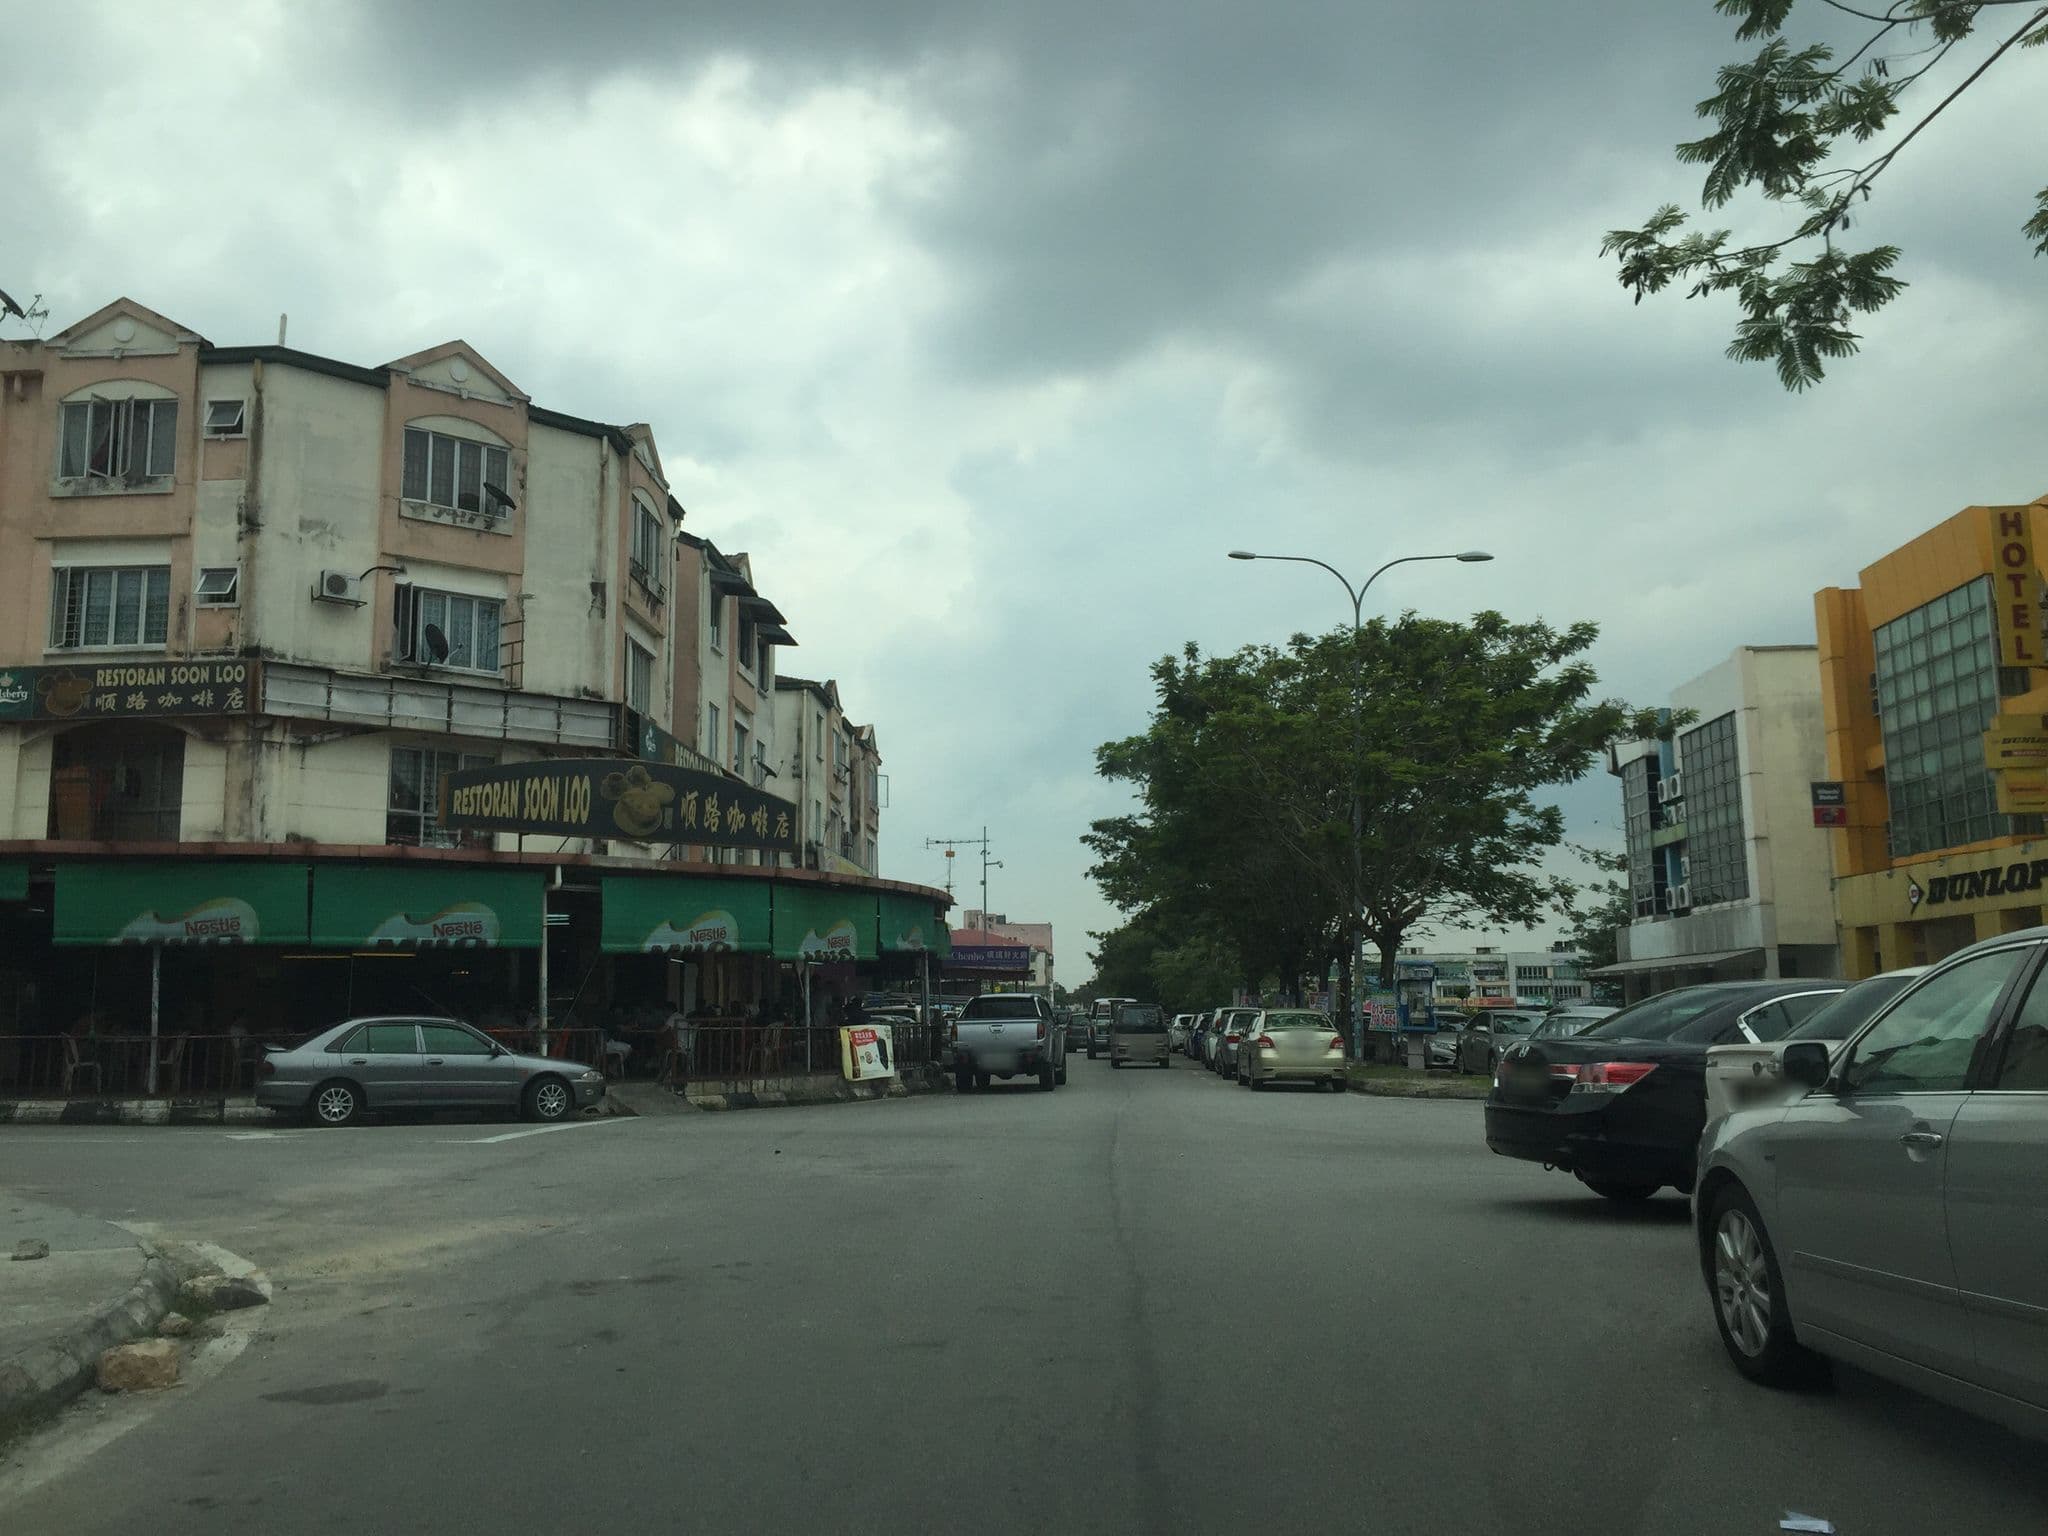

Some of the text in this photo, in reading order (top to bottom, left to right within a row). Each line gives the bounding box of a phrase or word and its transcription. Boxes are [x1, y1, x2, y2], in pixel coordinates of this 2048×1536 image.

[1999, 512, 2033, 660] HOTEL
[95, 664, 245, 687] RESTORAN SOON LOO
[95, 687, 245, 712] 顺路咖啡店
[452, 775, 592, 824] RESTORAN SOON LOO
[681, 791, 789, 839] 顺路咖啡店
